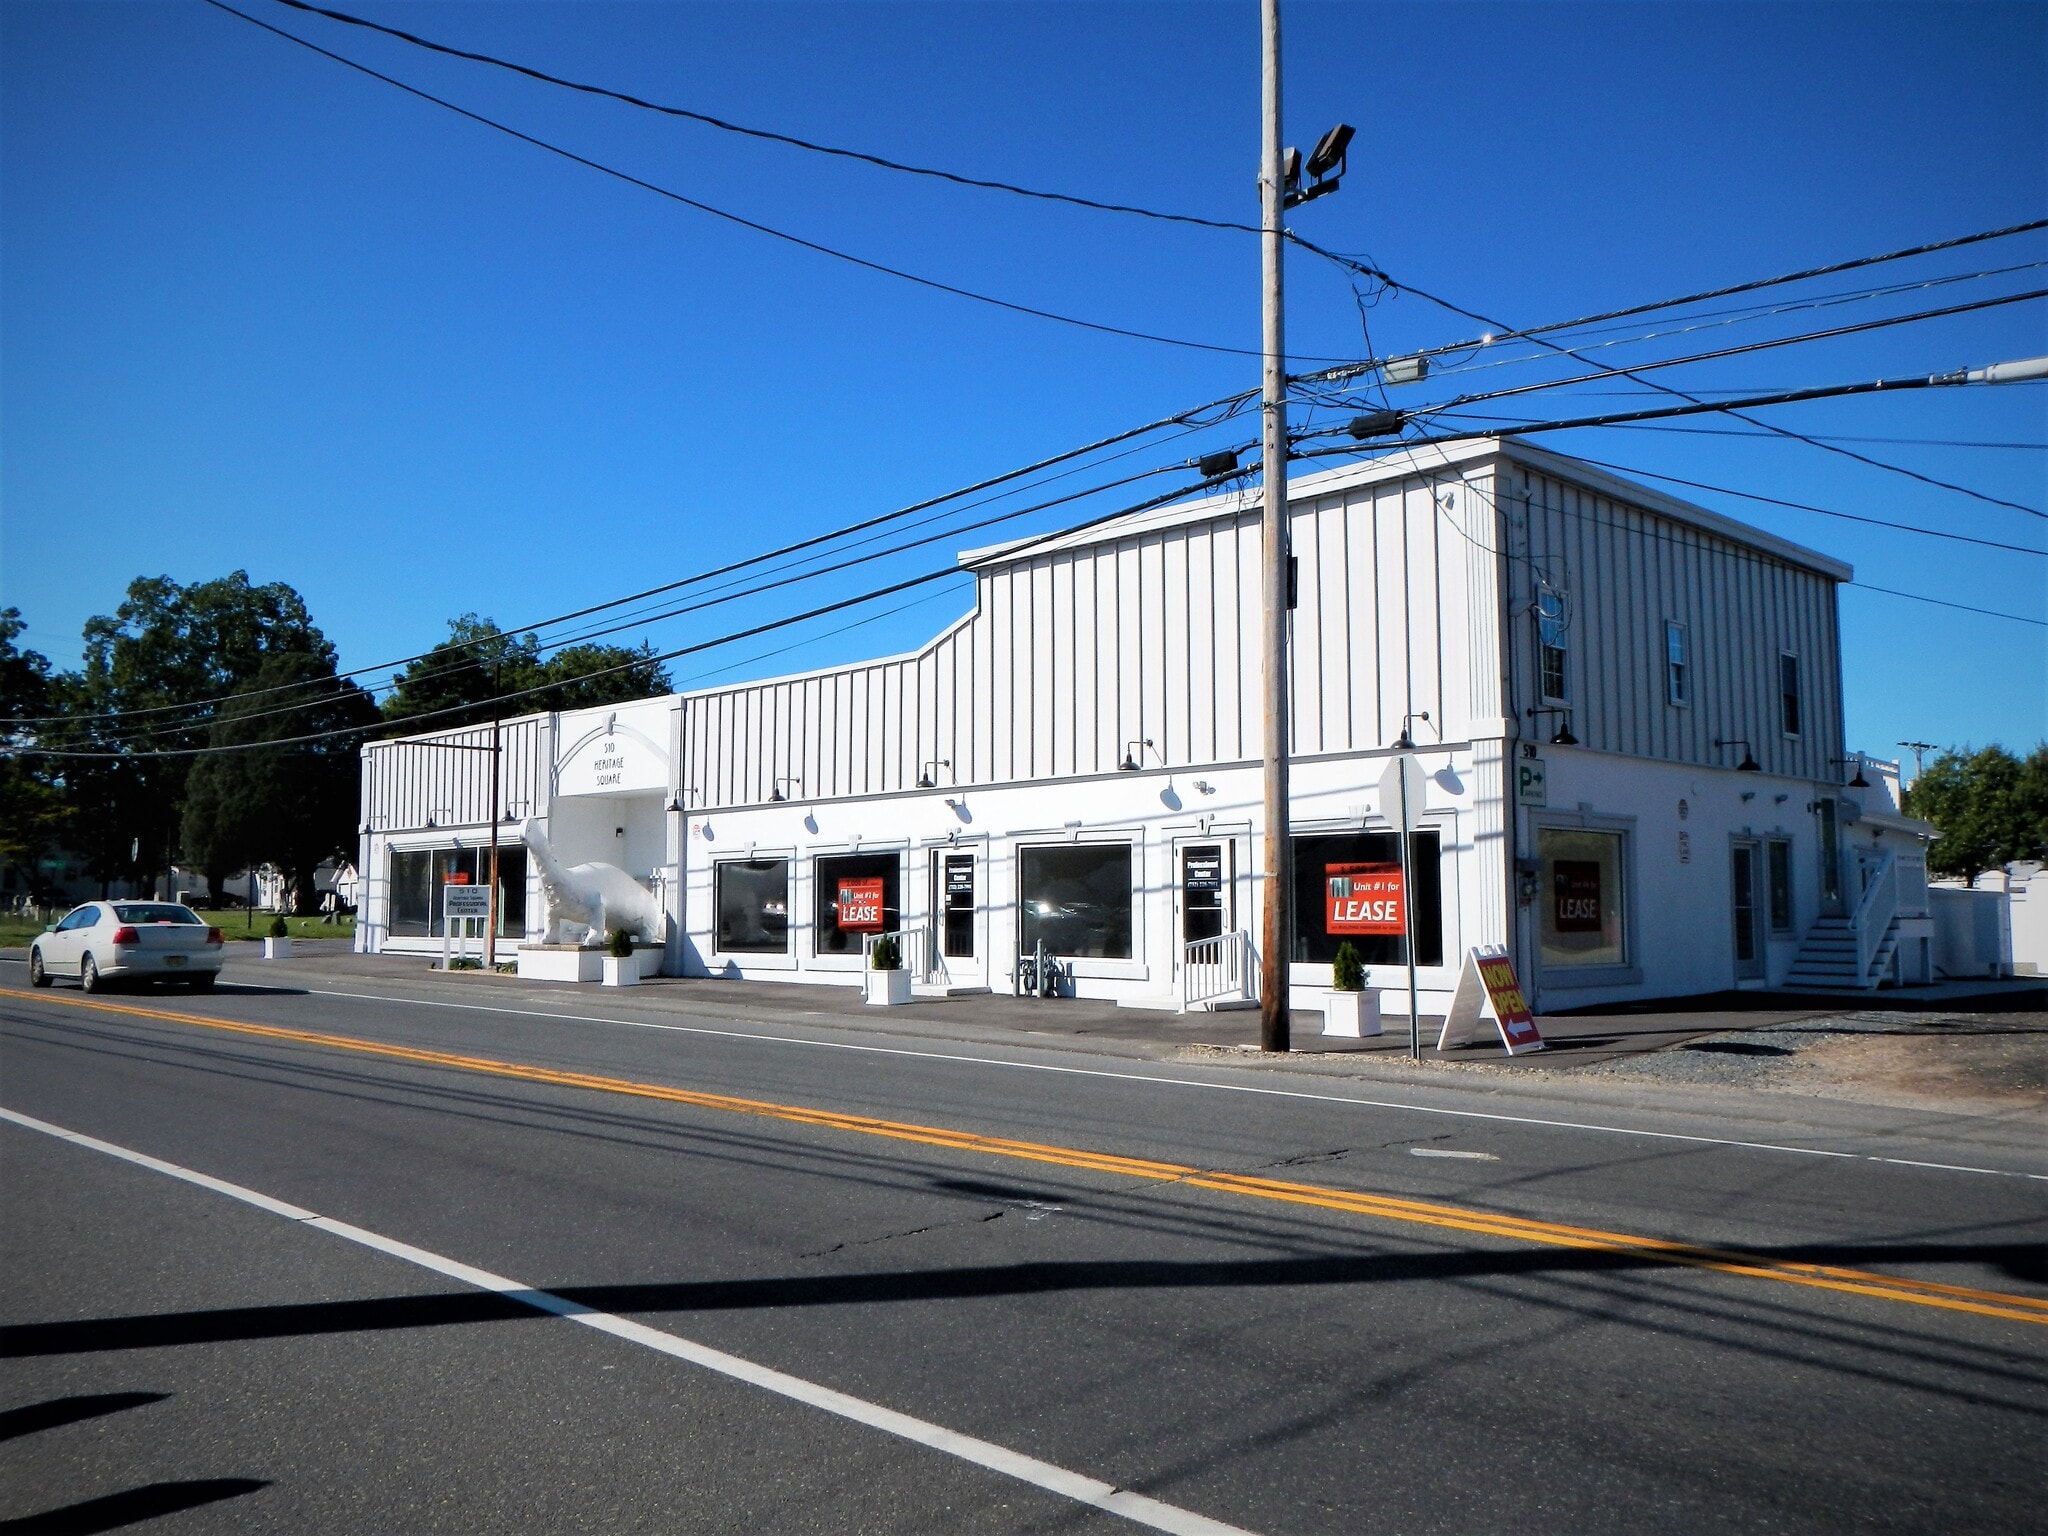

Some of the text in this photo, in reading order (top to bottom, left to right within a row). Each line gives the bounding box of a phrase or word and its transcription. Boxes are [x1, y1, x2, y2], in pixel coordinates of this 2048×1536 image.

[604, 742, 615, 753] 510
[1523, 744, 1536, 758] 510
[594, 757, 624, 770] HERITAGE
[597, 773, 621, 786] SQUARE
[1199, 818, 1204, 831] 1
[948, 832, 954, 842] 2
[1353, 882, 1371, 891] Unit
[1386, 882, 1400, 893] for
[842, 905, 878, 921] LEASE
[1333, 900, 1398, 921] LEASE
[1560, 898, 1597, 918] LEASE
[1482, 963, 1515, 989] NOW
[1491, 990, 1528, 1016] OPEN
